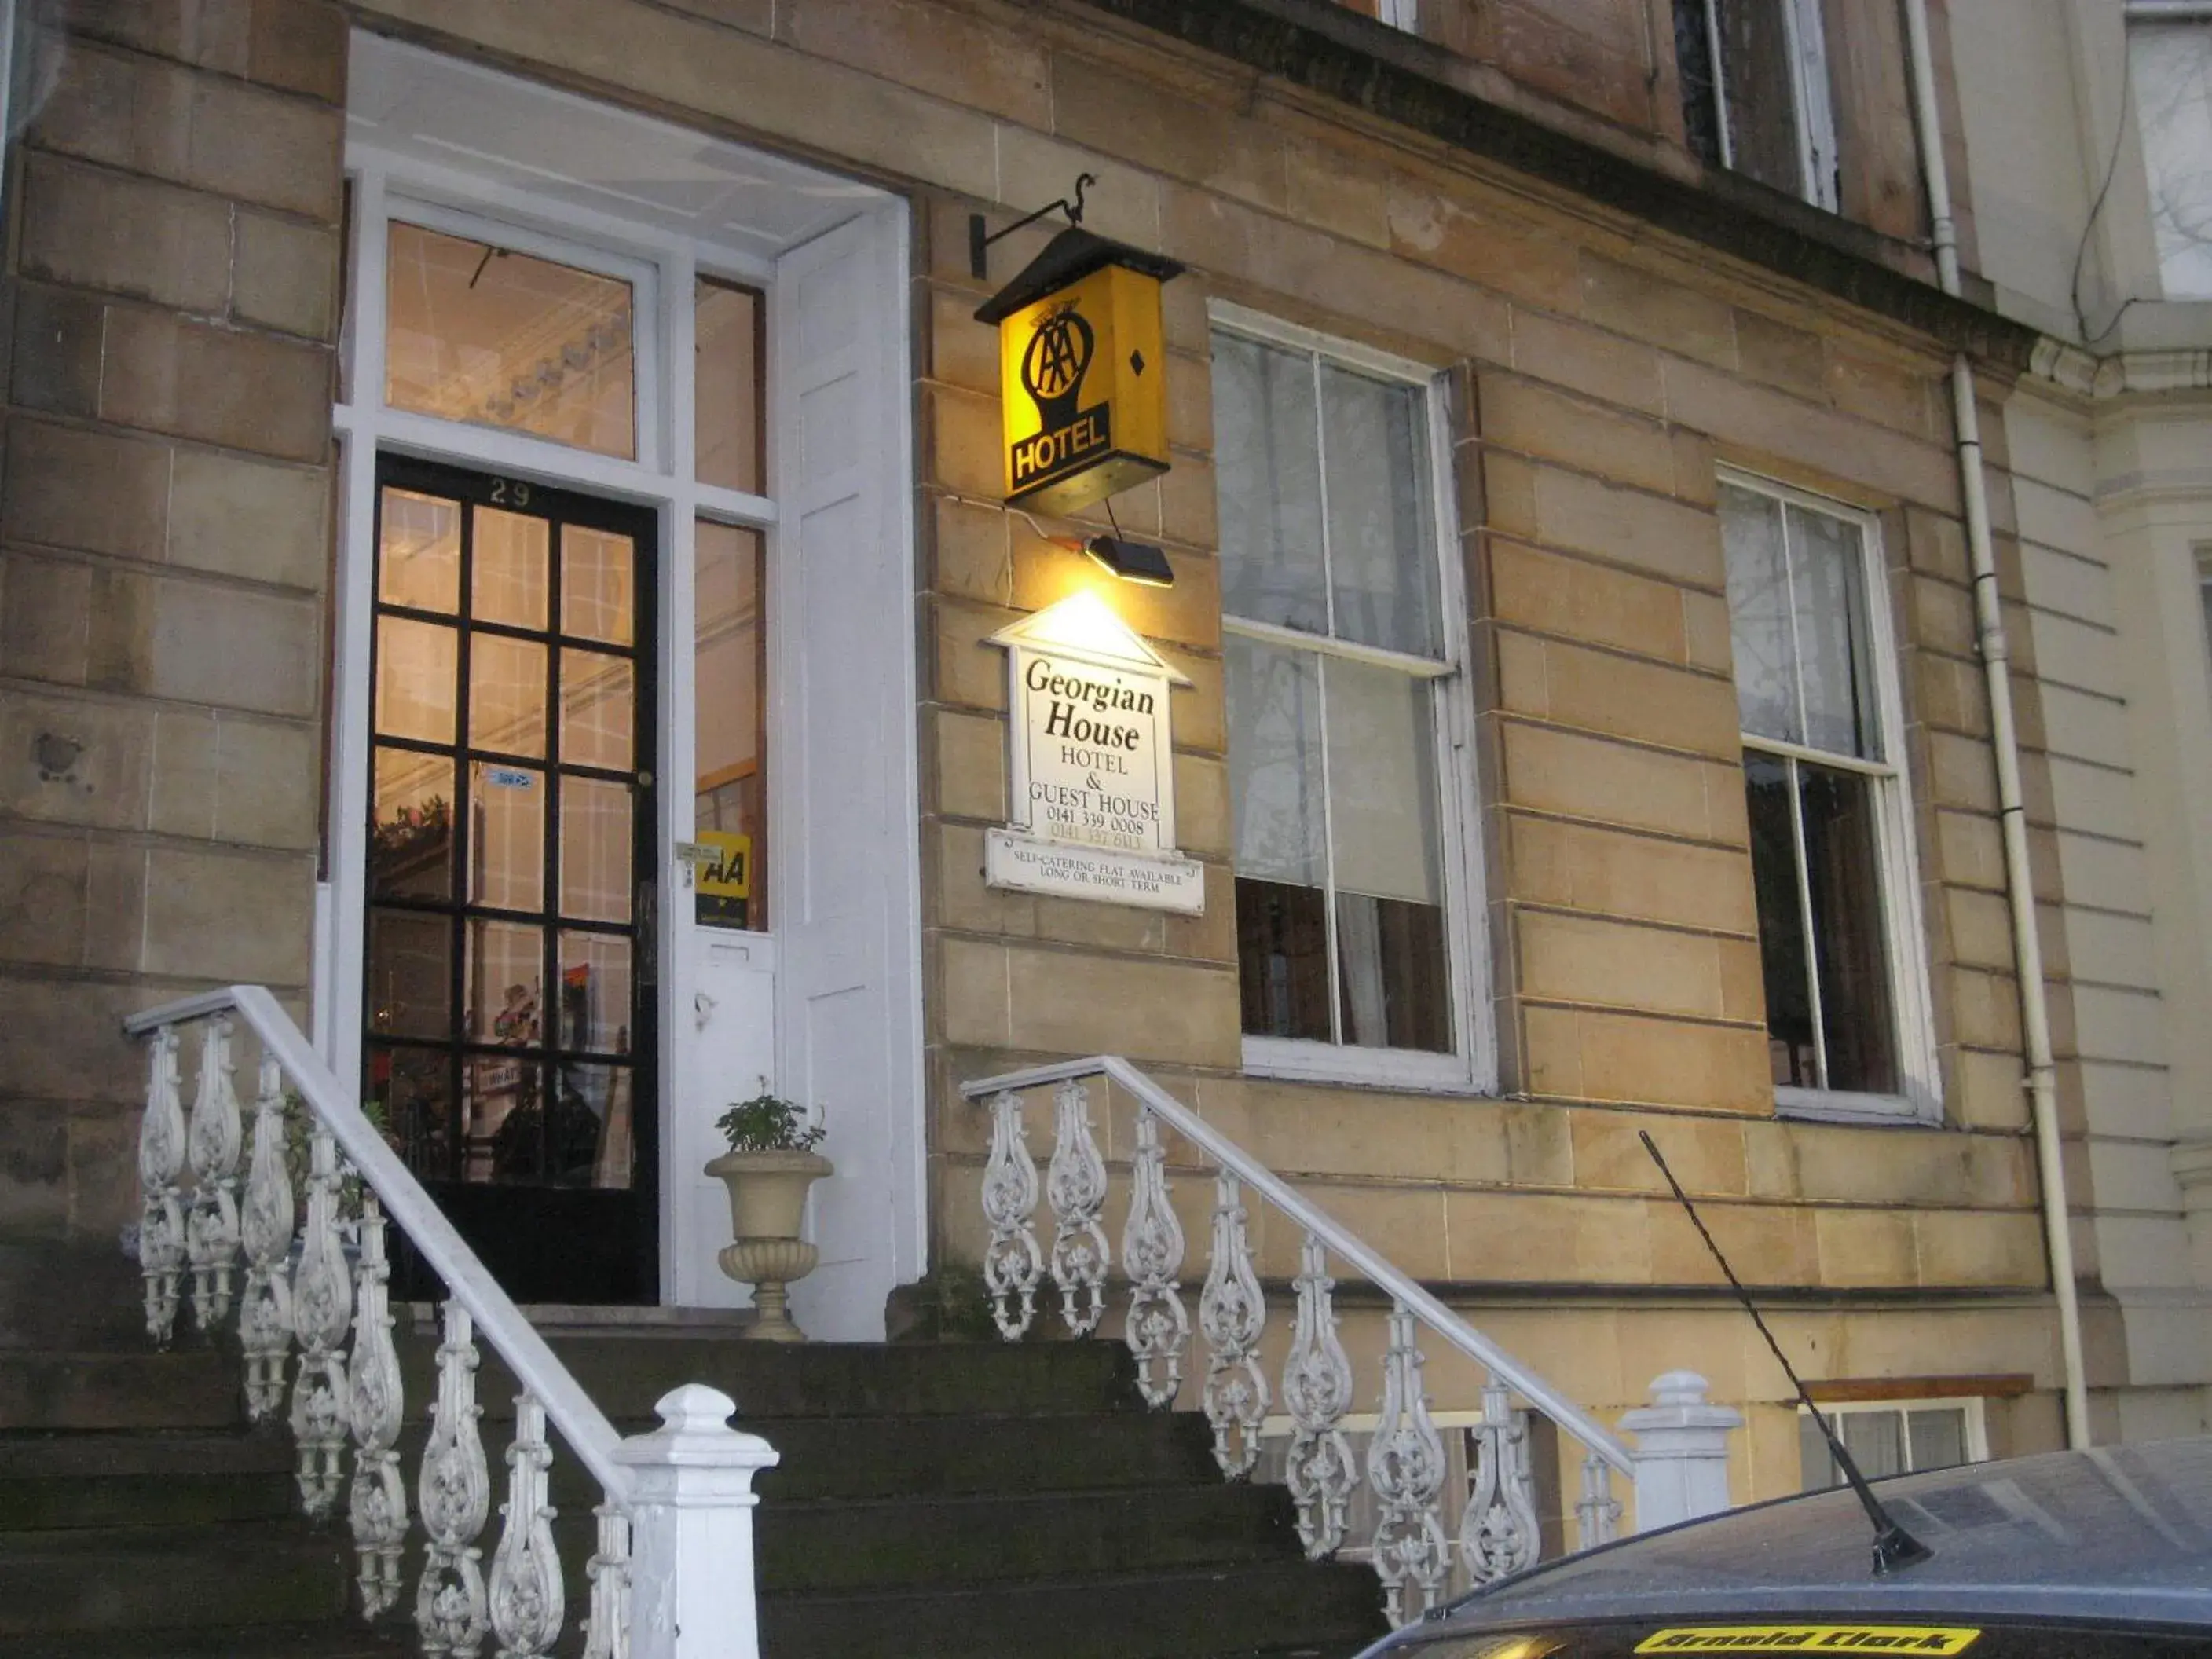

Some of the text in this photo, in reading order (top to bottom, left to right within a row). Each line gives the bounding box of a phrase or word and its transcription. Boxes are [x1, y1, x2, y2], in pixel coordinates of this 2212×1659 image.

[1016, 416, 1105, 479] HOTEL
[490, 476, 529, 507] 29
[1026, 660, 1155, 716] Georgian
[1044, 701, 1141, 751] House
[1061, 745, 1129, 775] HOTEL
[1086, 771, 1103, 791] &
[1029, 781, 1160, 822] GUEST HOUSE
[1046, 805, 1144, 835] 0141 339 0008
[1014, 851, 1183, 886] SELF-CATERING FLAT AVAILABLE
[1040, 865, 1160, 894] LONG OR SHORT TERM
[1652, 1631, 1954, 1650] Arnold Clark
